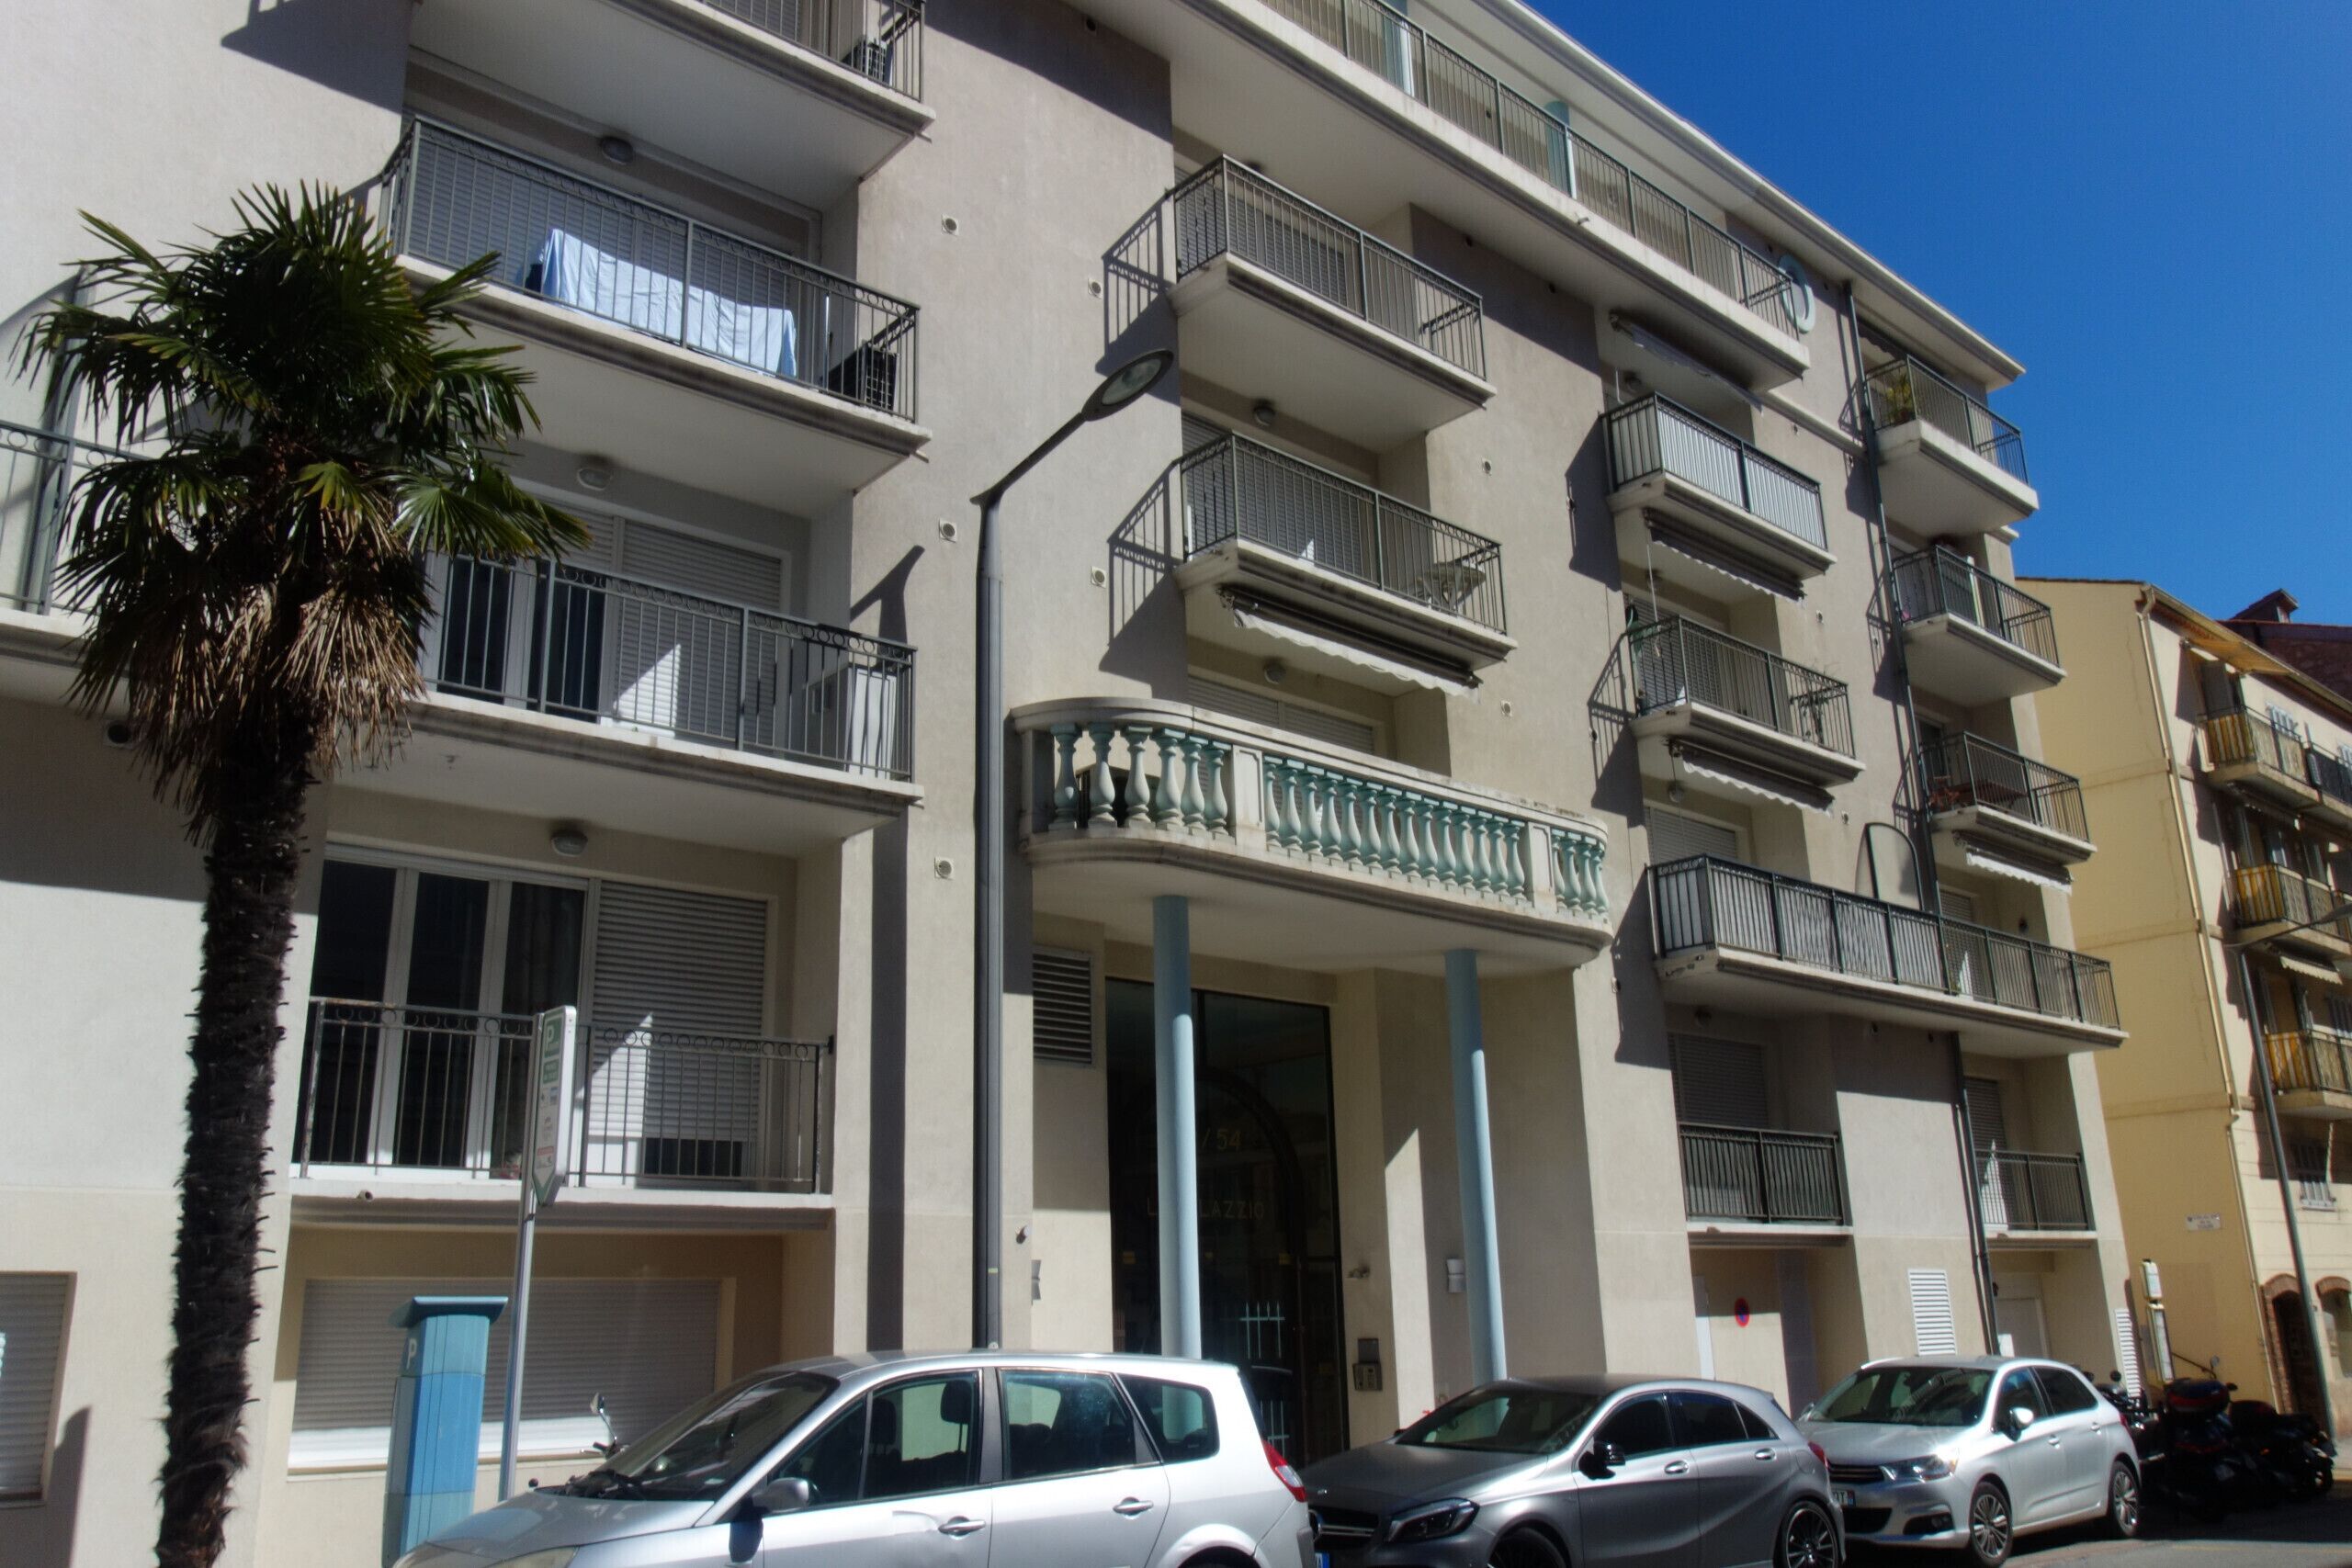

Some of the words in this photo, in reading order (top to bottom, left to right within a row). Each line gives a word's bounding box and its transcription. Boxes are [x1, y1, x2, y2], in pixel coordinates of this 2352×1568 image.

[546, 1025, 554, 1052] P
[1199, 1199, 1265, 1220] LAZZIO
[406, 1338, 417, 1369] P
